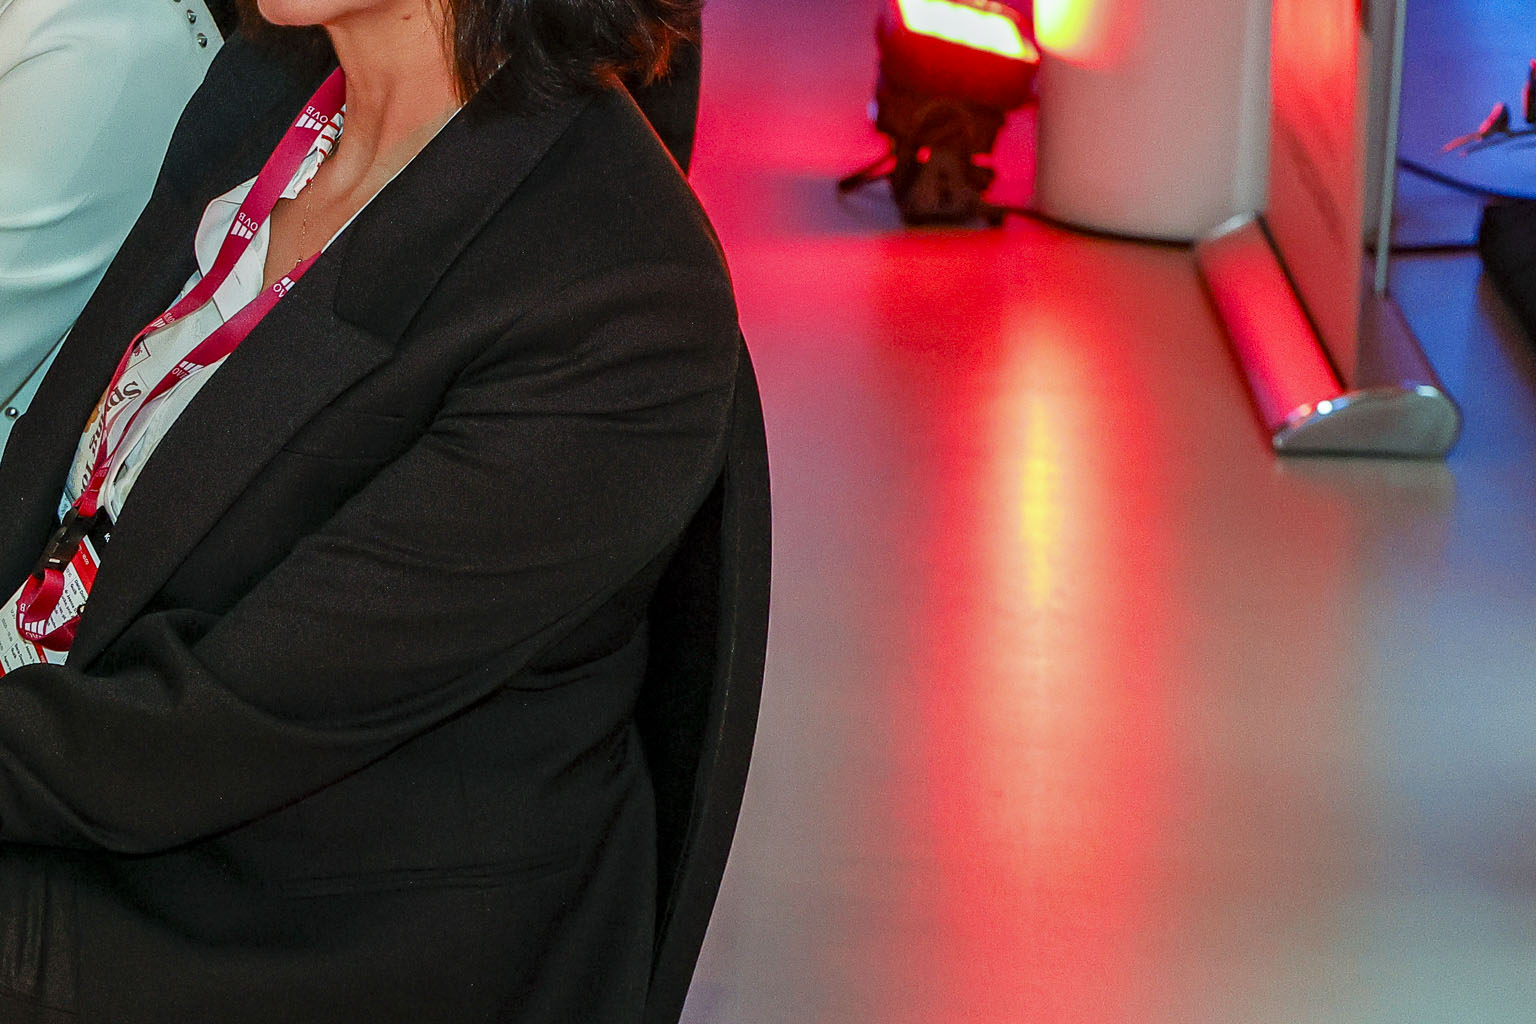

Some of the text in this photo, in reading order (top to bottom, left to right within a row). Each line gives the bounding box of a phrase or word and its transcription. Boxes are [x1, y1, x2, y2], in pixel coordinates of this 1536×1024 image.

[305, 105, 329, 124] OVB
[238, 212, 259, 232] OVB
[272, 283, 285, 298] OV
